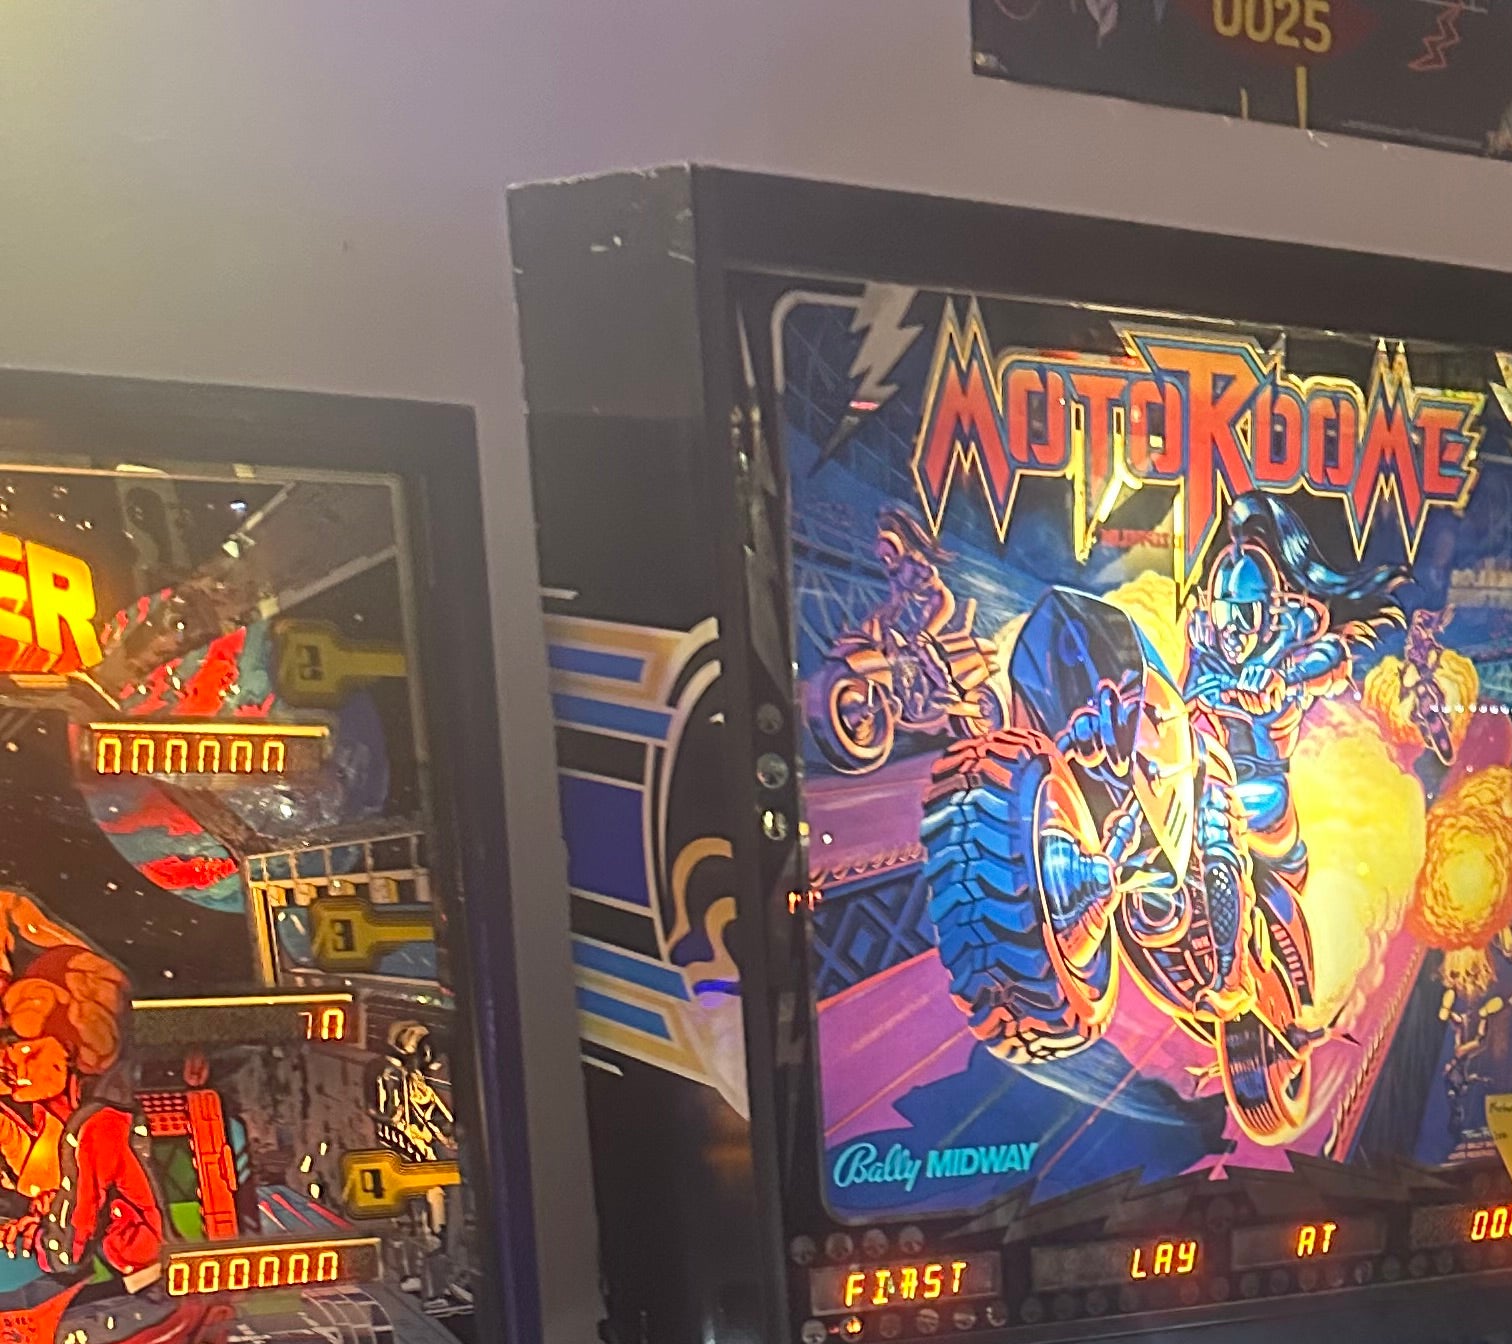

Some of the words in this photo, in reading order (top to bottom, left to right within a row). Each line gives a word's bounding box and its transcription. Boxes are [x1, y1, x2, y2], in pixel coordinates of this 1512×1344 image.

[912, 298, 1485, 600] MOTORDOME
[833, 1142, 922, 1192] Bally
[926, 1142, 1039, 1178] MIDWAY
[844, 1260, 968, 1307] FIRST
[1297, 1222, 1338, 1258] AT
